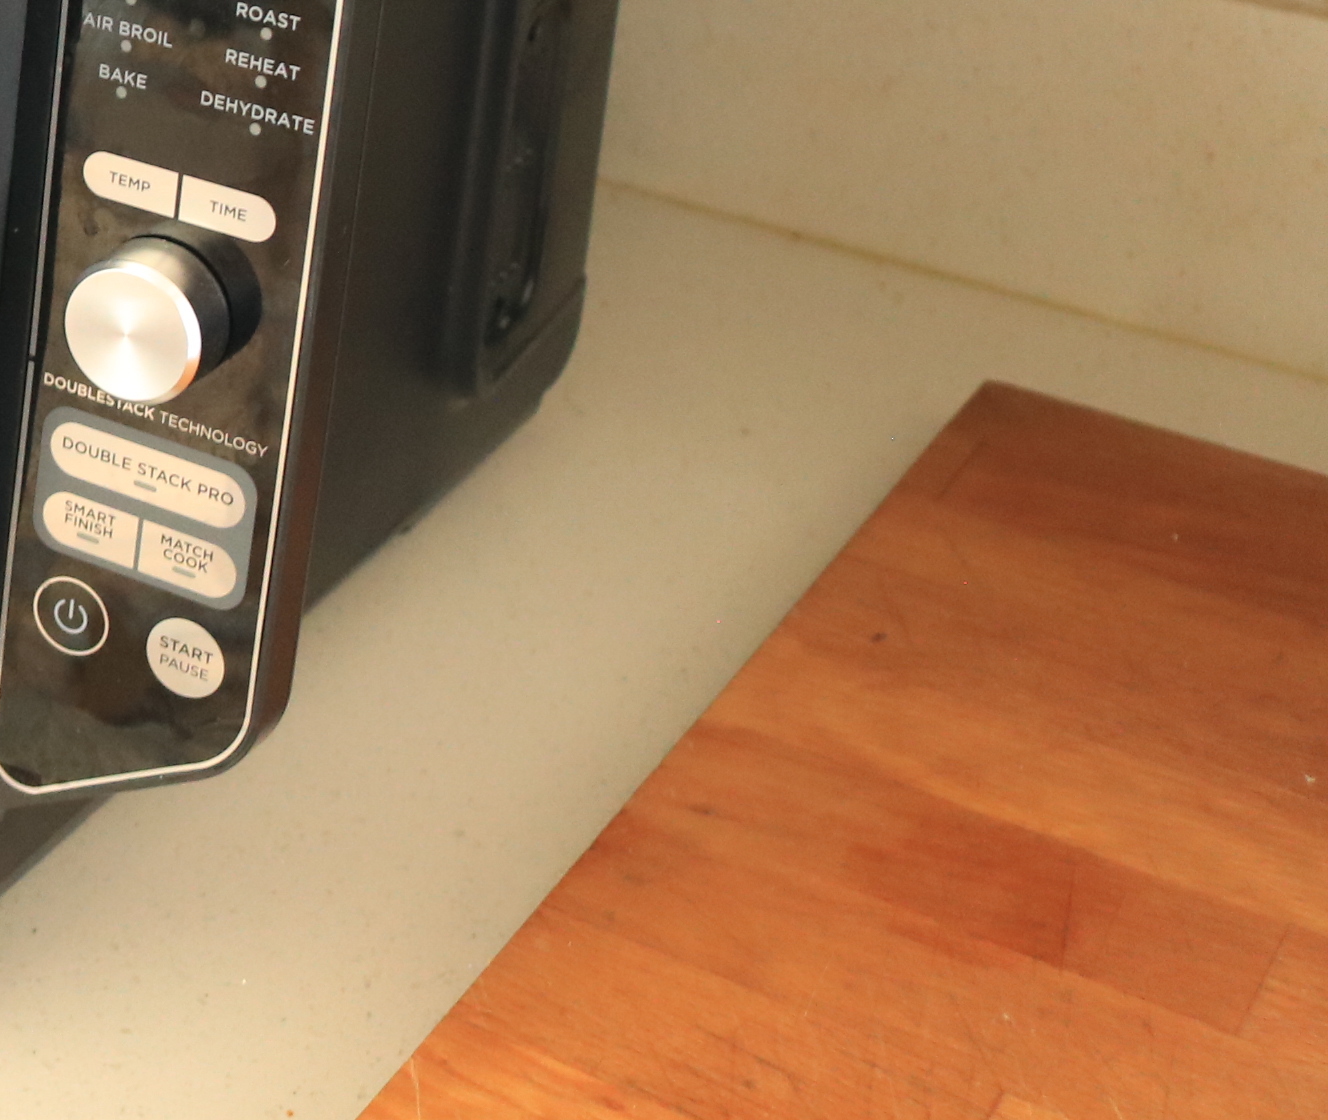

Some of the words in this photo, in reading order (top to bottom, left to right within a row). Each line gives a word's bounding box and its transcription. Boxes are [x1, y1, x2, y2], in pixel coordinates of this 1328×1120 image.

[83, 12, 113, 33] AIR
[118, 21, 173, 48] BROIL
[236, 2, 301, 31] ROAST
[98, 63, 148, 89] BAKE
[225, 48, 301, 79] REHEAT
[200, 90, 315, 135] DEHYDRATE
[109, 170, 151, 193] TEMP
[209, 199, 247, 222] TIME
[159, 410, 268, 458] TECHNOLOGY
[62, 436, 132, 471] DOUBLE
[137, 463, 192, 492] STACK
[197, 484, 234, 506] PRO
[64, 500, 116, 526] SMART
[64, 513, 114, 539] FINISH
[160, 534, 214, 562] MATCH
[162, 548, 209, 574] COOK
[160, 635, 213, 664] START
[159, 655, 209, 682] PAUSE
